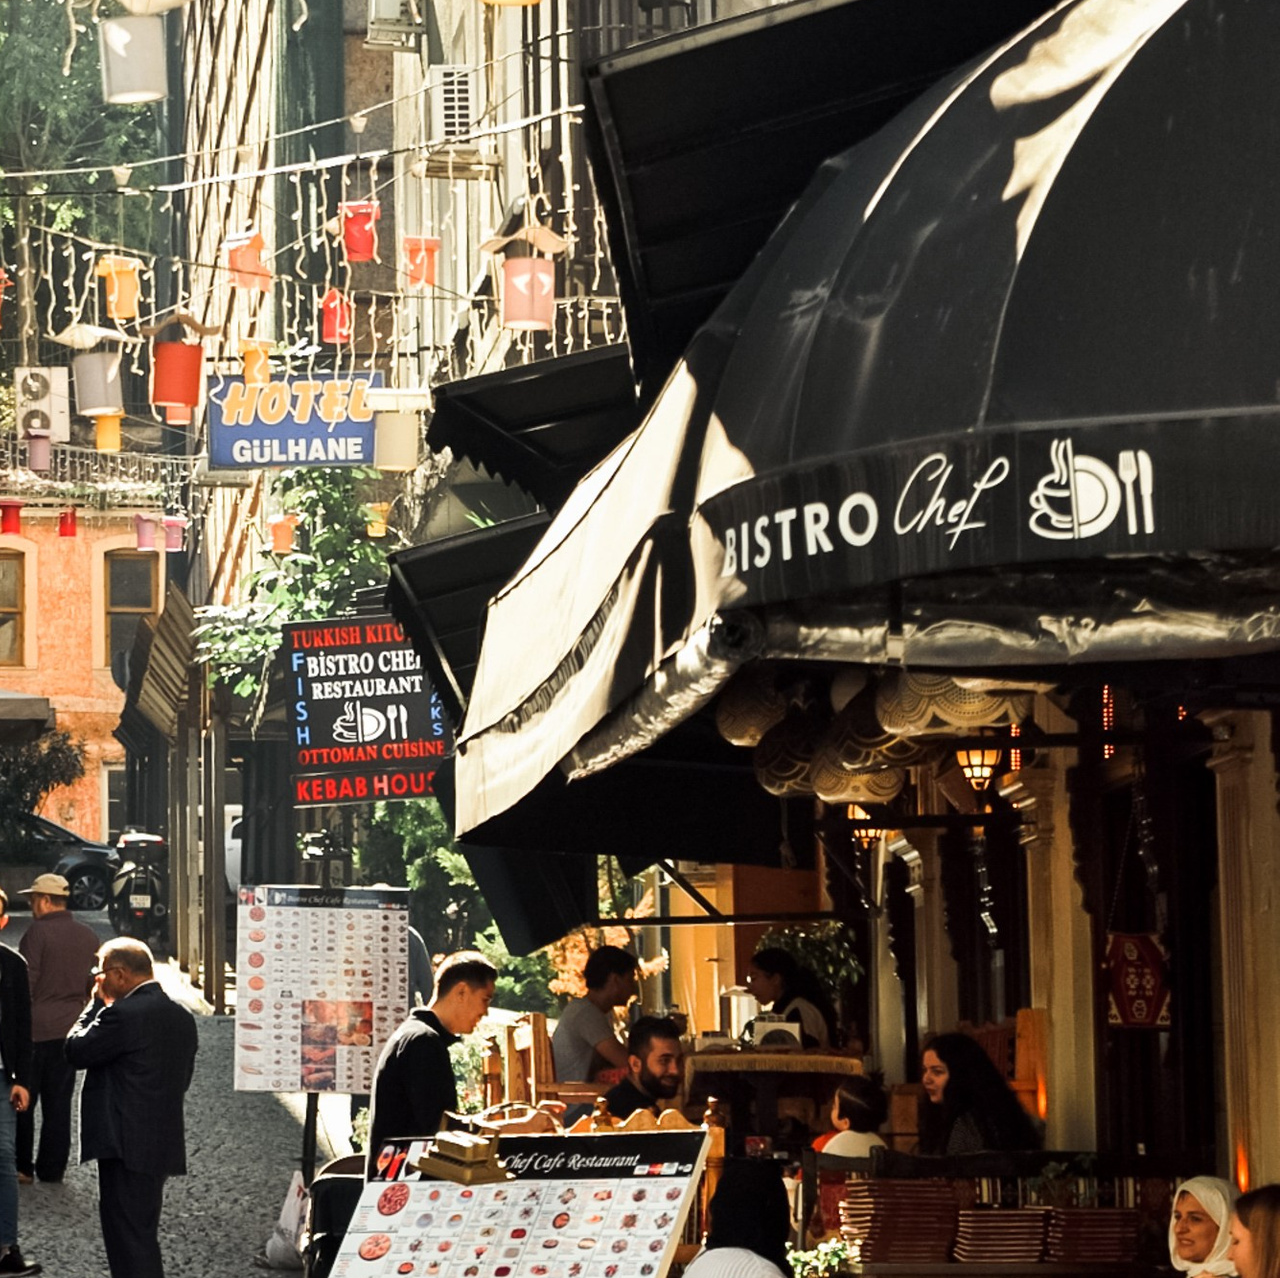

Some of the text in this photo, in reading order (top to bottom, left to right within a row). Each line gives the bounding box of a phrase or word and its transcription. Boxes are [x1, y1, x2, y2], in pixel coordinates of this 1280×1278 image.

[222, 379, 374, 426] HOTEL
[232, 437, 363, 463] GÜLHANE
[721, 453, 1010, 577] BISTRO Chef
[291, 626, 361, 649] TURKISH
[307, 649, 422, 677] BİSTRO CHE
[312, 675, 423, 700] RESTAURANT
[298, 746, 378, 765] OTTOMAN
[297, 777, 368, 801] KEBAB
[505, 1151, 641, 1173] Chef Cafe Restaurant
